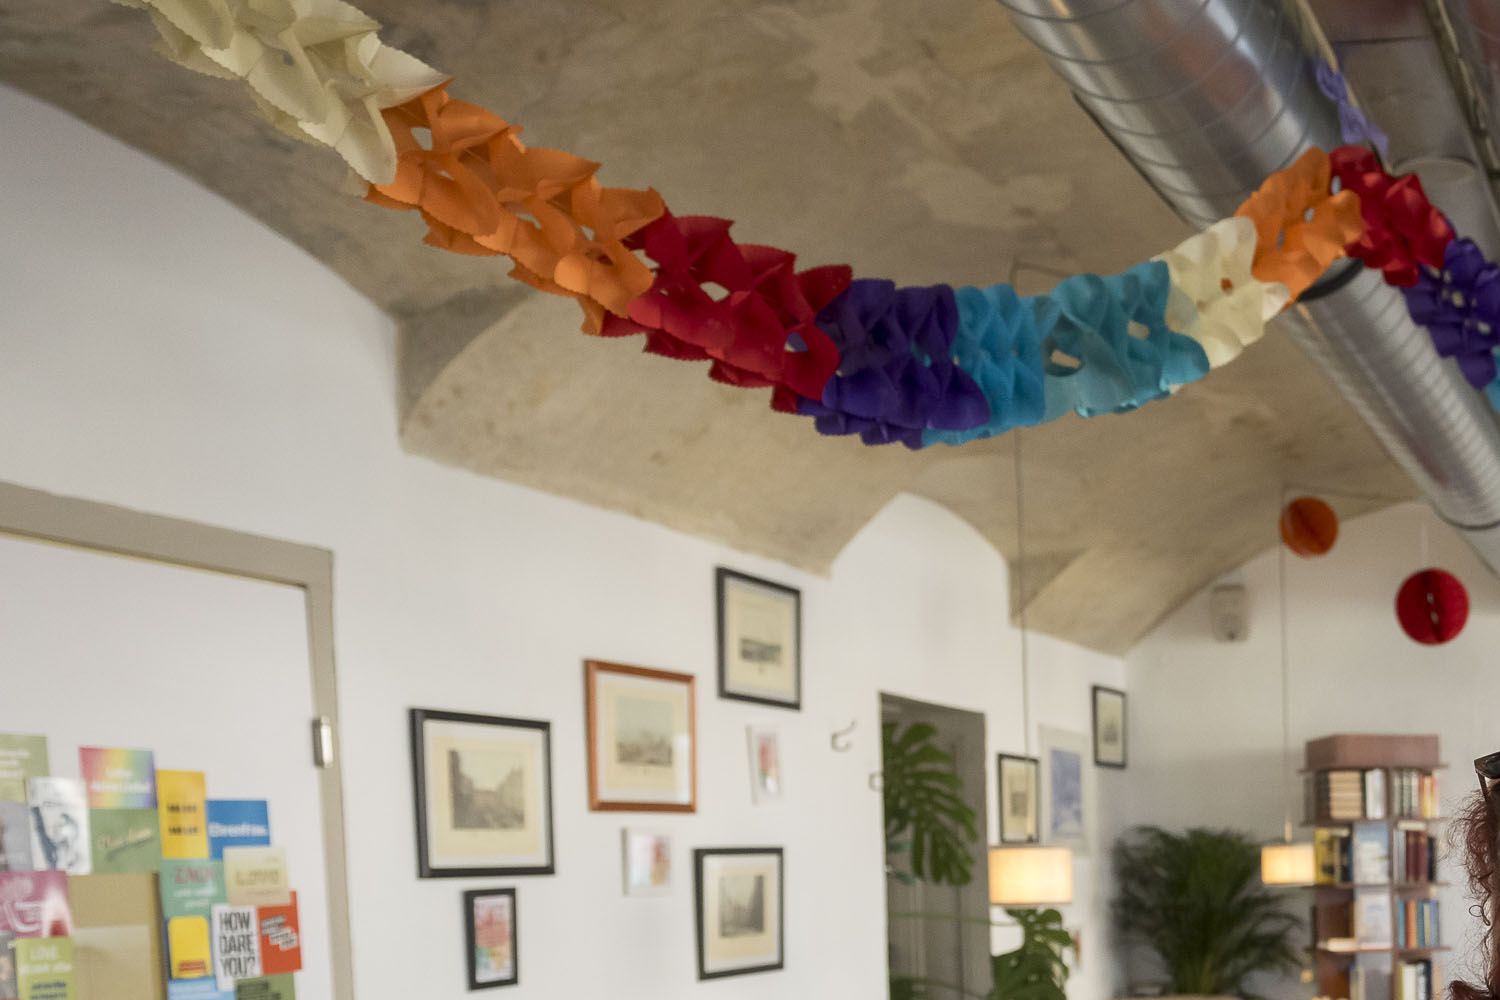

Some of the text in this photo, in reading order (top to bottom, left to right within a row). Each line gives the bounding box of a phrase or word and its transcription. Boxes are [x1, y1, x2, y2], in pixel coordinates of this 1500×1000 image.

[219, 911, 251, 931] HOW
[219, 934, 255, 954] DARE
[220, 956, 256, 978] YOU?
